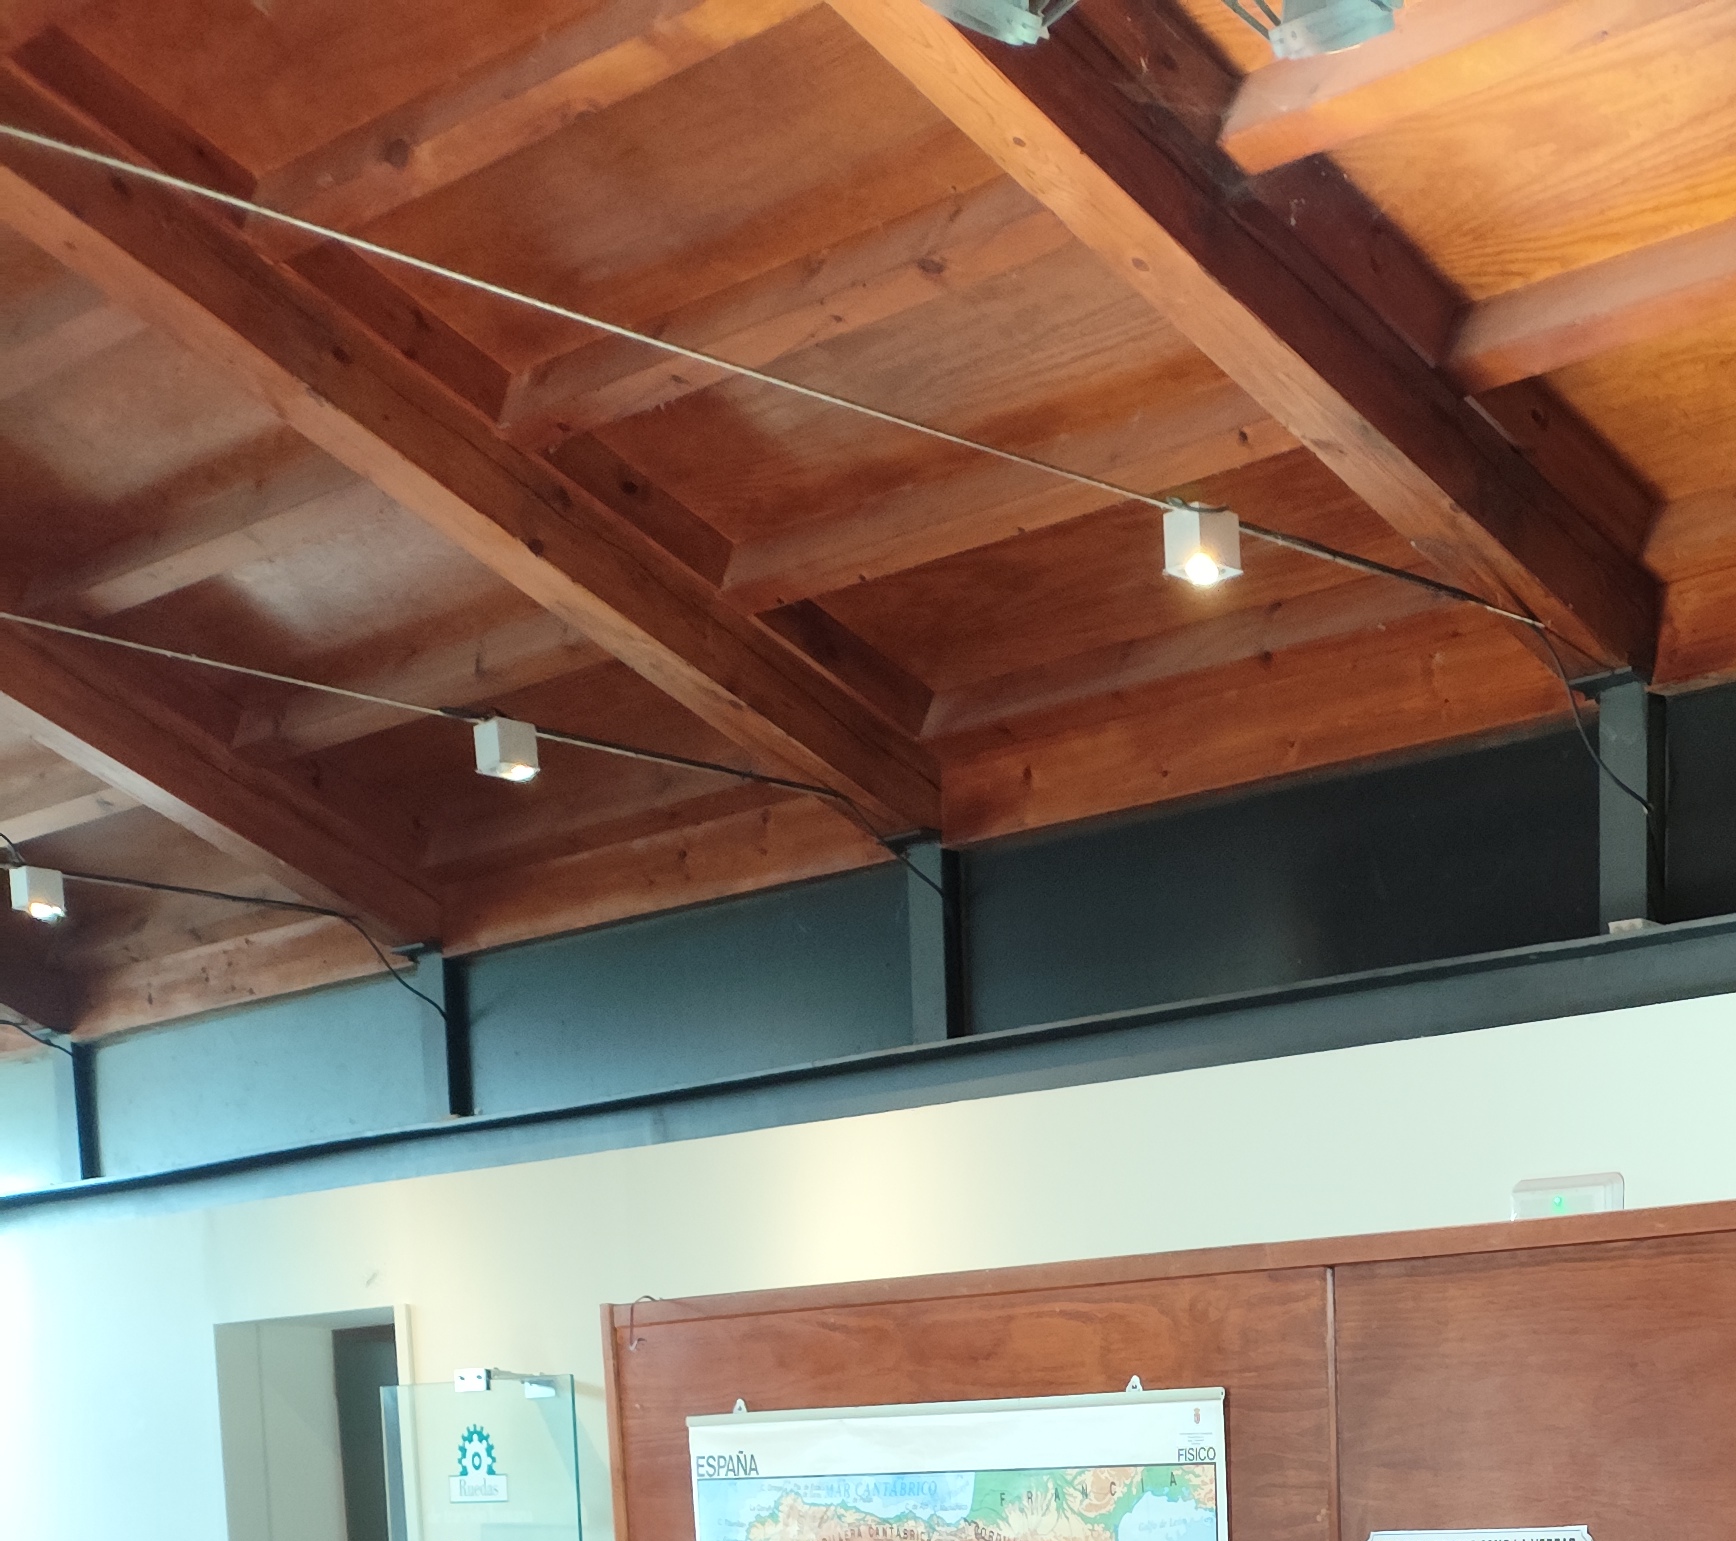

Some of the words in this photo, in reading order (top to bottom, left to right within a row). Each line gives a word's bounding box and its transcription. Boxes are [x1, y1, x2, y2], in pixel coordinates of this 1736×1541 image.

[1177, 1446, 1217, 1462] FISICO
[696, 1450, 759, 1477] ESPAÑA
[458, 1478, 499, 1497] Ruedas
[826, 1483, 851, 1498] MAR
